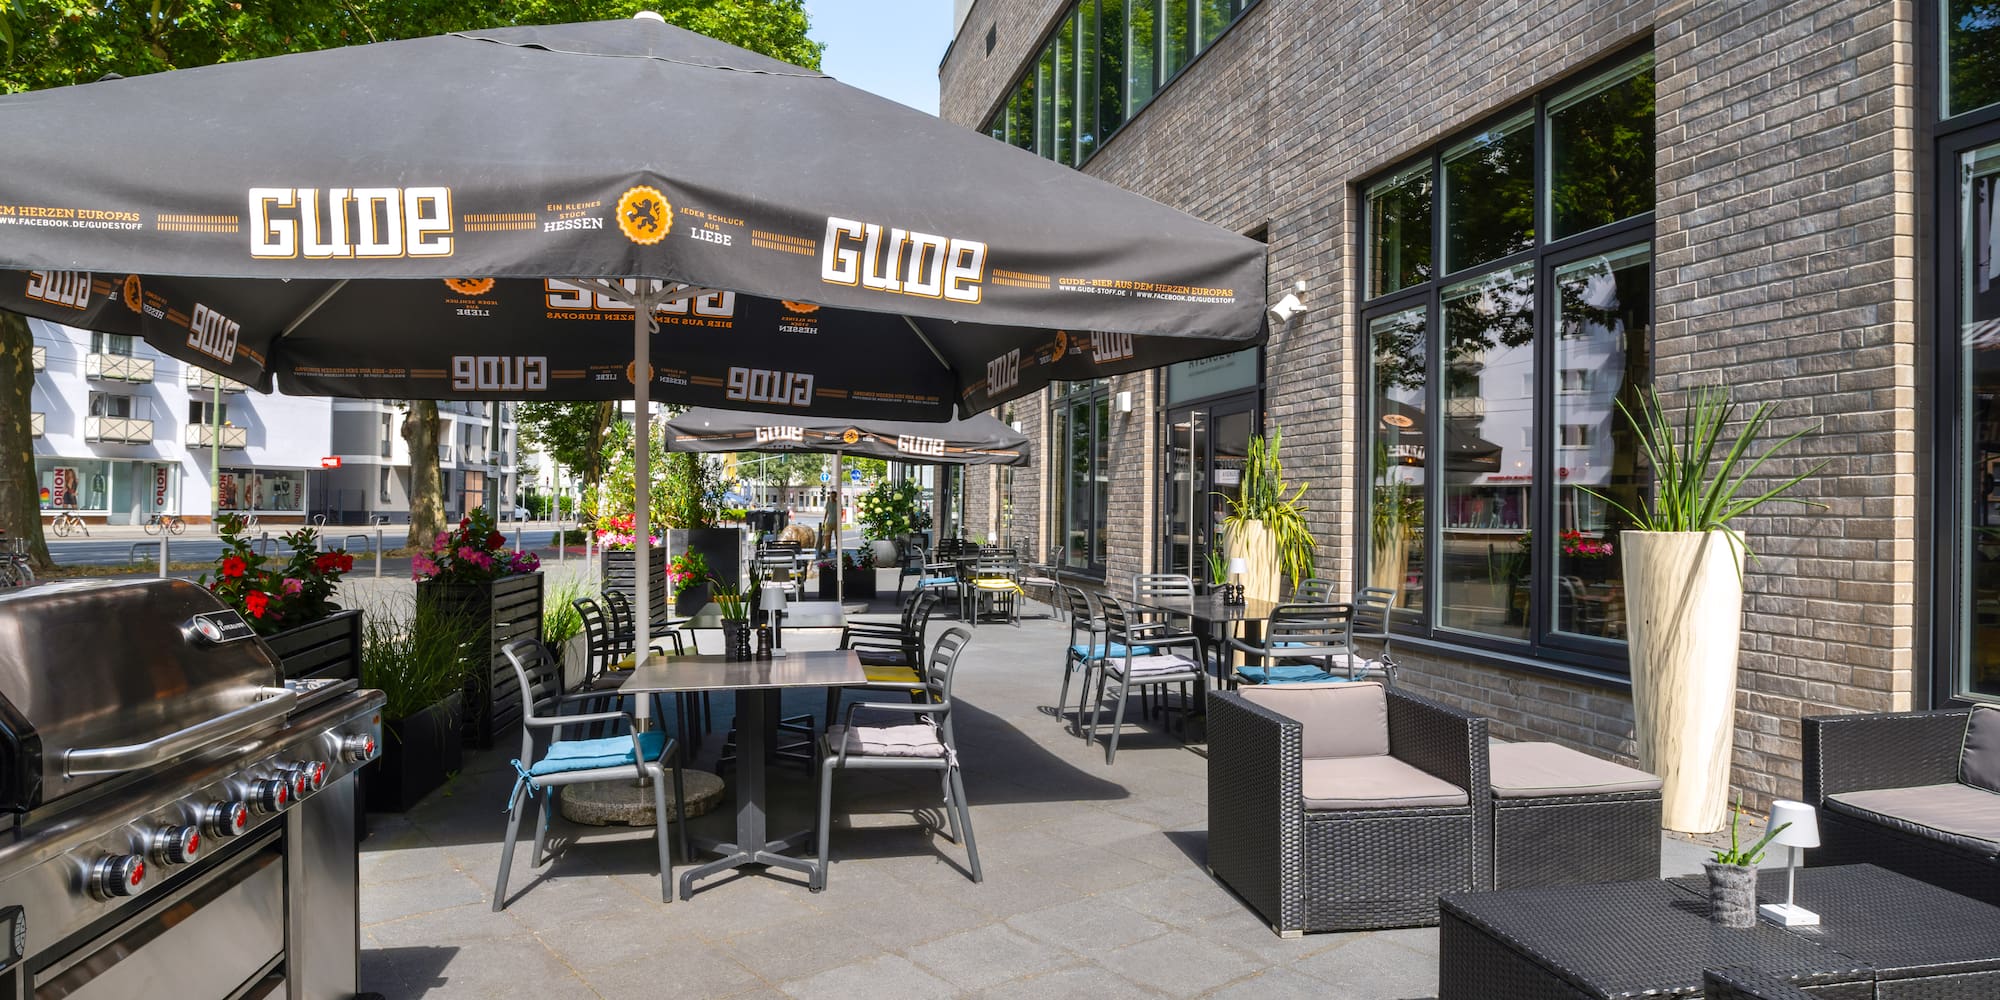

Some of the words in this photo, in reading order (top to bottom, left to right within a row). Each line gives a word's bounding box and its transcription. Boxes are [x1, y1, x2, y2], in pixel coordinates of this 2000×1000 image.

[19, 206, 75, 218] HERZEN
[78, 209, 140, 222] EUROPAS
[547, 204, 562, 212] EIN
[566, 200, 601, 210] KLEINES
[543, 217, 603, 233] HESSEN
[680, 207, 705, 218] JEDER
[707, 213, 745, 226] SCHLUCK
[704, 221, 720, 231] AUS
[690, 226, 732, 246] LIEBE
[1114, 280, 1133, 289] AUS
[1134, 282, 1153, 291] DEM
[1155, 283, 1190, 295] HERZEN
[1191, 287, 1233, 297] EUROPAS
[54, 468, 64, 506] ORION
[157, 467, 165, 506] ORION
[219, 474, 227, 507] ORION
